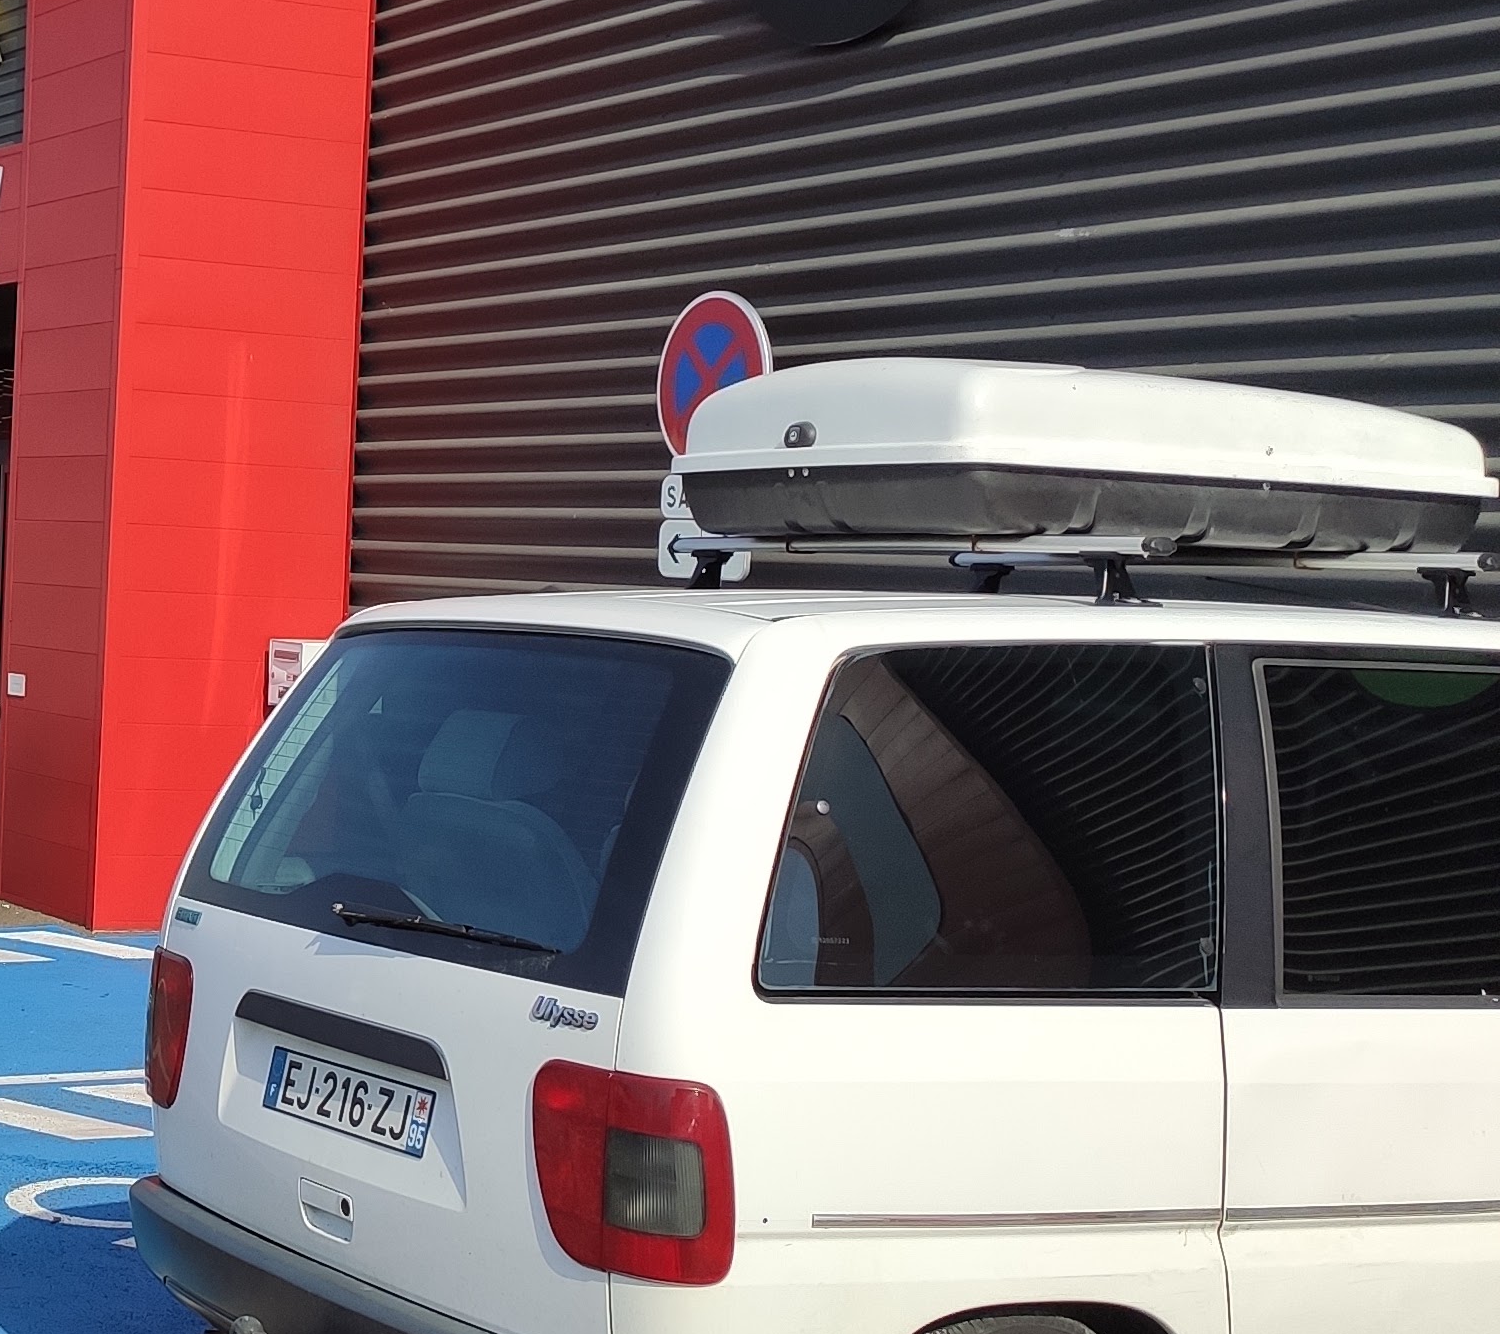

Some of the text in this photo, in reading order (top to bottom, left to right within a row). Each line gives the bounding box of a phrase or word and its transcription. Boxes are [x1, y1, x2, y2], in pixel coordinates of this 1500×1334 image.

[530, 994, 599, 1031] Ulysse
[269, 1083, 278, 1097] F
[407, 1124, 426, 1149] 95
